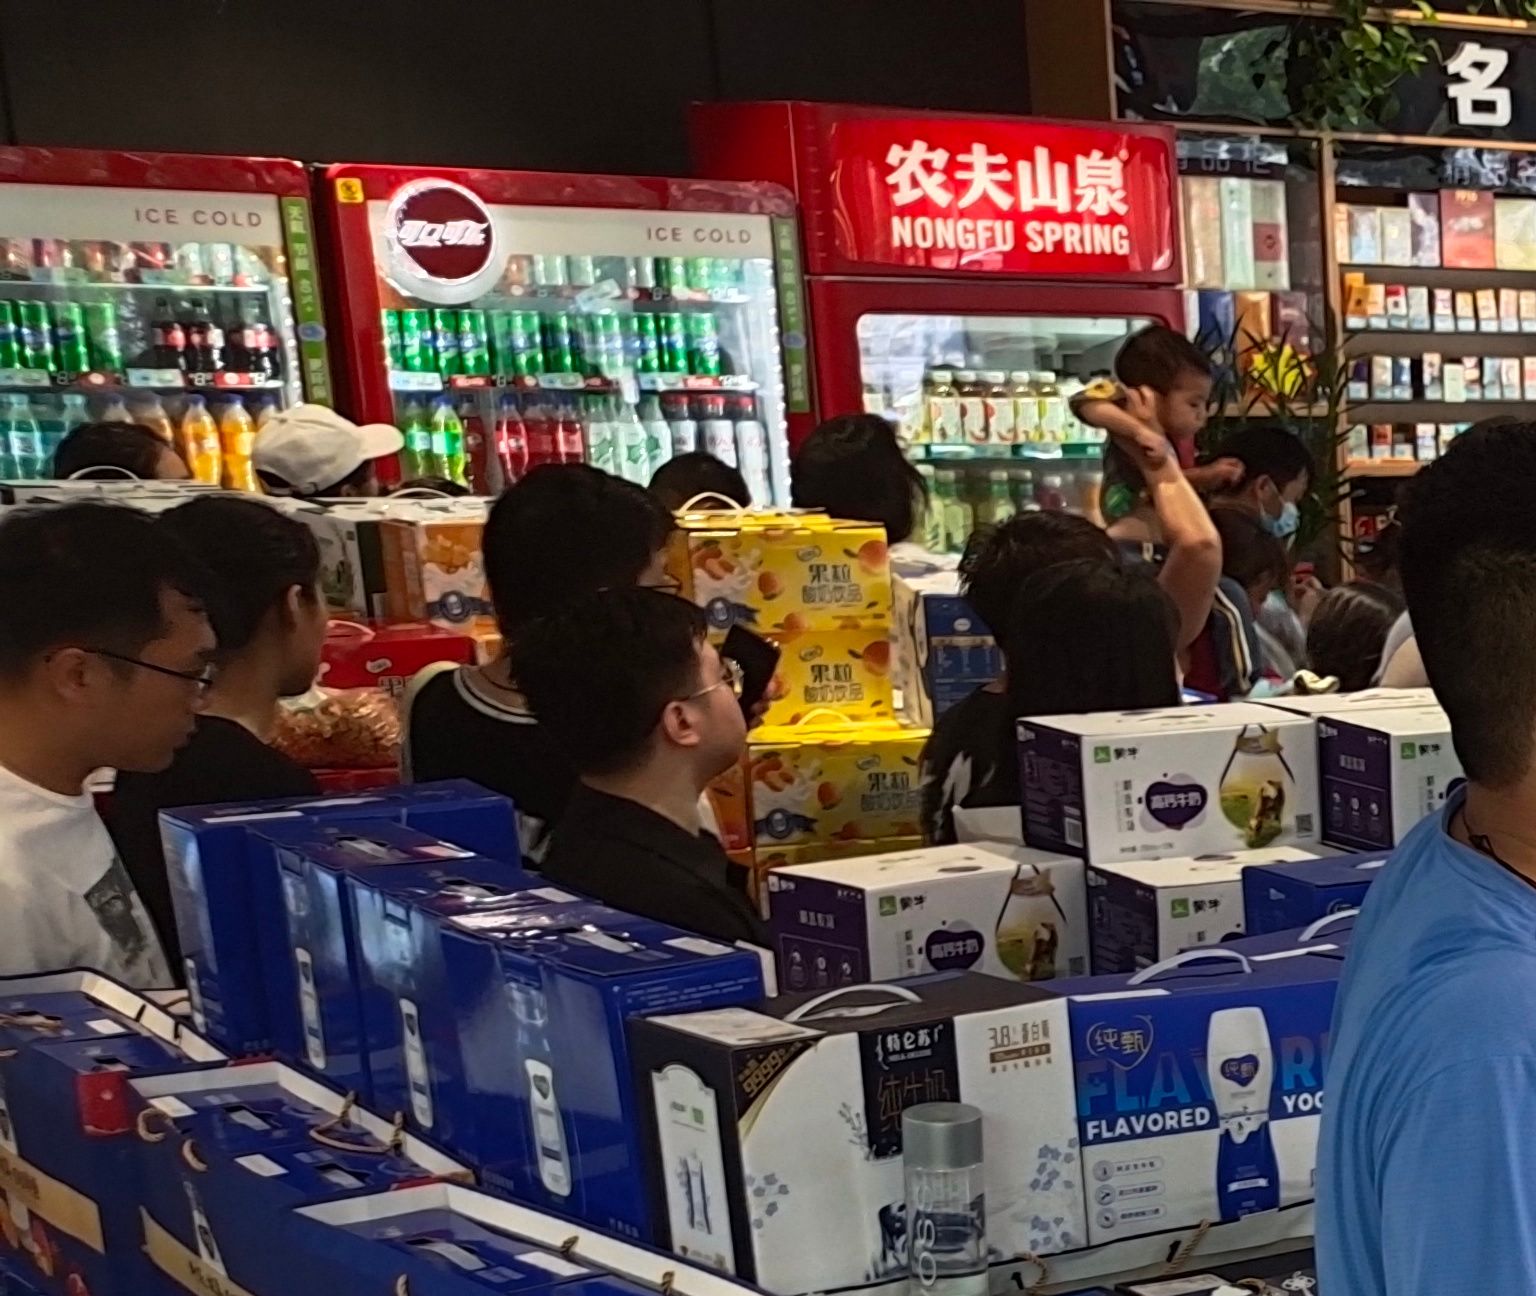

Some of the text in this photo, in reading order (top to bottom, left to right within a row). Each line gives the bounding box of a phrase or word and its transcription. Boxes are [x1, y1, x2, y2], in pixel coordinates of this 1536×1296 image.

[886, 141, 1130, 218] 农夫山泉
[134, 207, 262, 228] ICE COLD
[646, 227, 752, 244] ICE COLD
[891, 215, 1131, 257] NONGFU SPRING
[887, 1030, 932, 1053] 特仑苏
[1093, 1027, 1147, 1055] 纯甄
[1086, 1107, 1211, 1141] FLAVORED
